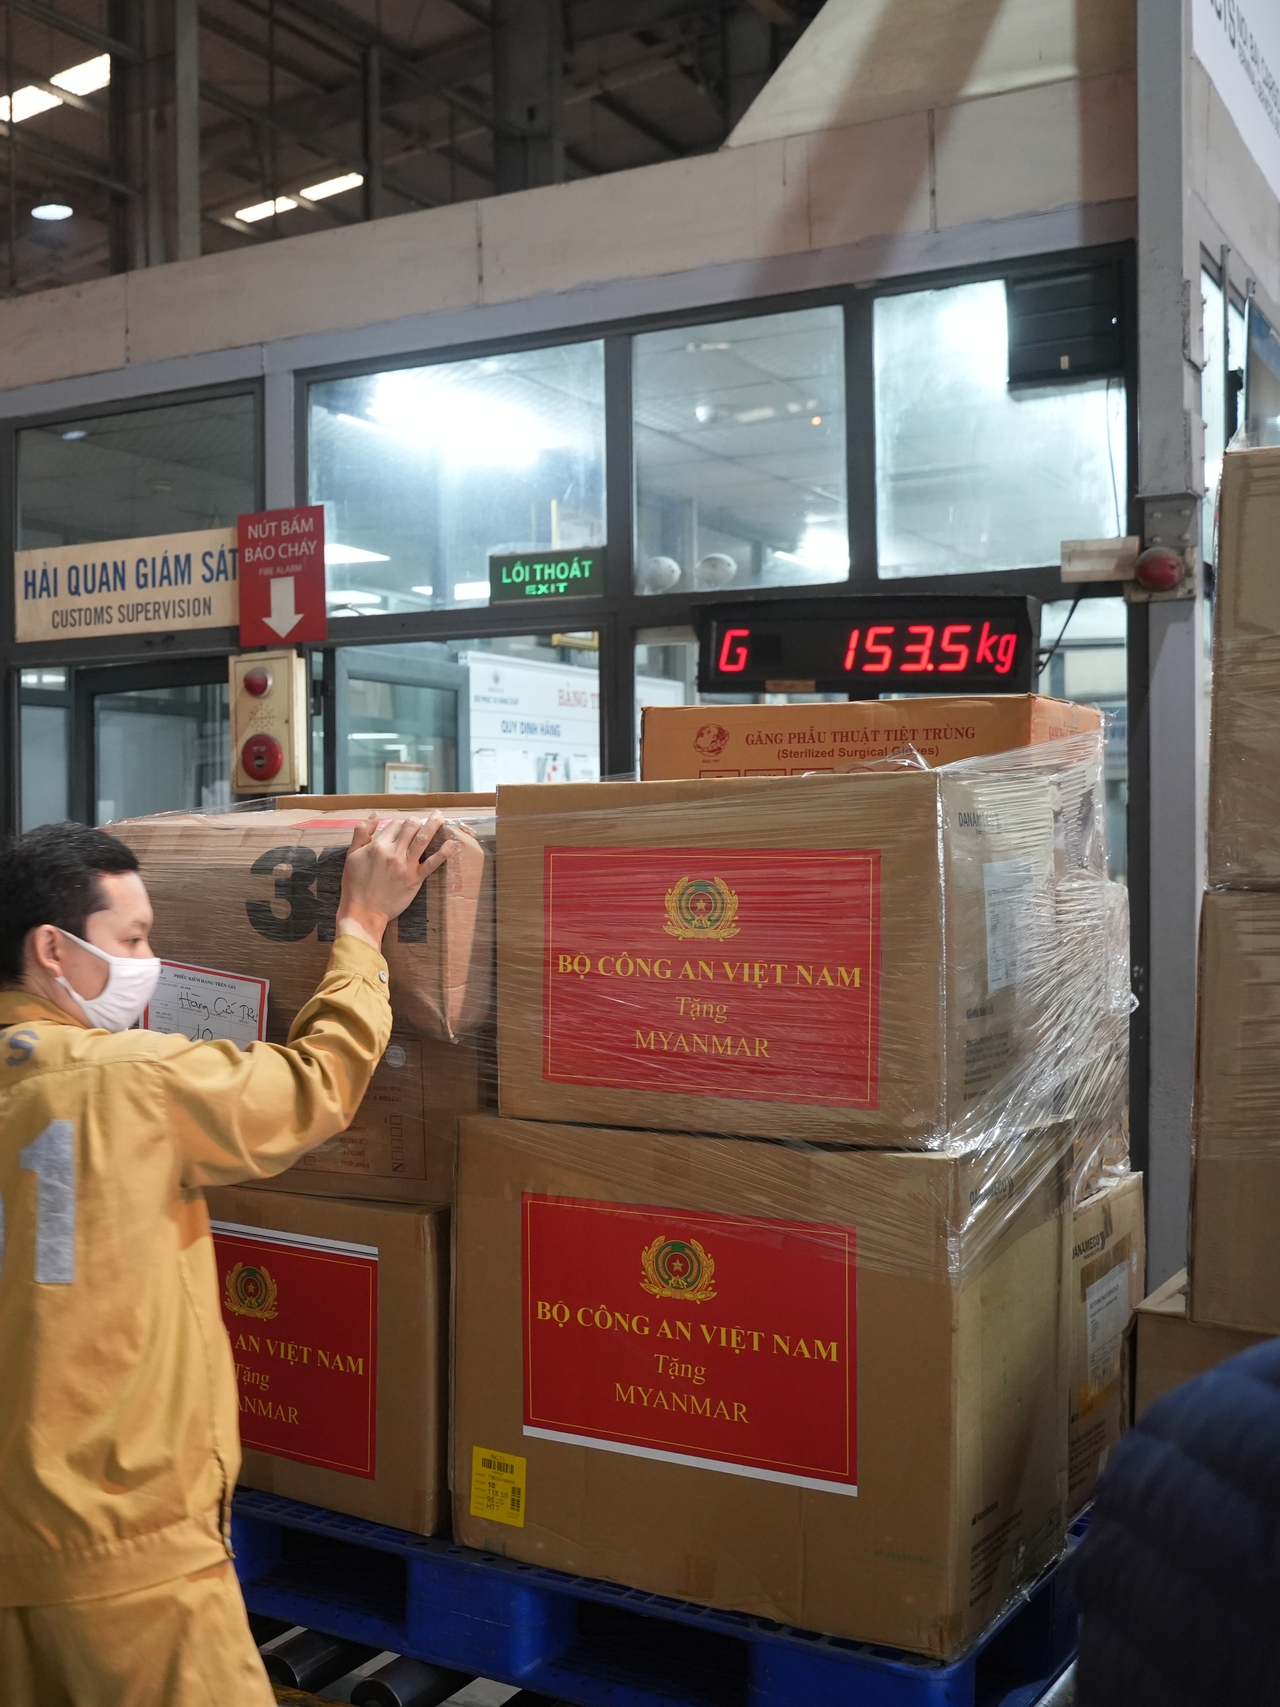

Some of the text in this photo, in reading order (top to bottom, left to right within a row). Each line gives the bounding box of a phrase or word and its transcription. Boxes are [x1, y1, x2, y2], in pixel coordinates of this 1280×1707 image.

[247, 514, 314, 540] NÚT BẤM
[245, 540, 317, 562] BÁO CHÁY
[23, 544, 239, 600] HẢI QUAN GIÁM SÁT
[259, 563, 302, 576] FIRE ALARM
[533, 556, 593, 581] THOÁT
[525, 582, 568, 595] EXIT
[51, 596, 213, 629] CUSTOMS SUPERVISION
[719, 628, 750, 672] G
[745, 725, 976, 746] GĂNG PHẪU THUẬT TIỆT TRÙNG
[777, 748, 835, 760] (Sterilized
[838, 746, 888, 758] Surgical
[557, 951, 862, 989] BỘ CÔNG AN VIỆT NAM
[675, 996, 729, 1024] Tặng
[635, 1029, 771, 1058] MYANMAR
[536, 1300, 840, 1363] BỘ CÔNG AN VIỆT NAM
[235, 1333, 365, 1376] AN VIỆT NAM
[234, 1362, 270, 1391] Tặng
[653, 1354, 707, 1385] Tặng
[238, 1395, 299, 1425] NMAR
[615, 1382, 750, 1424] MYANMAR
[488, 1481, 496, 1489] 10
